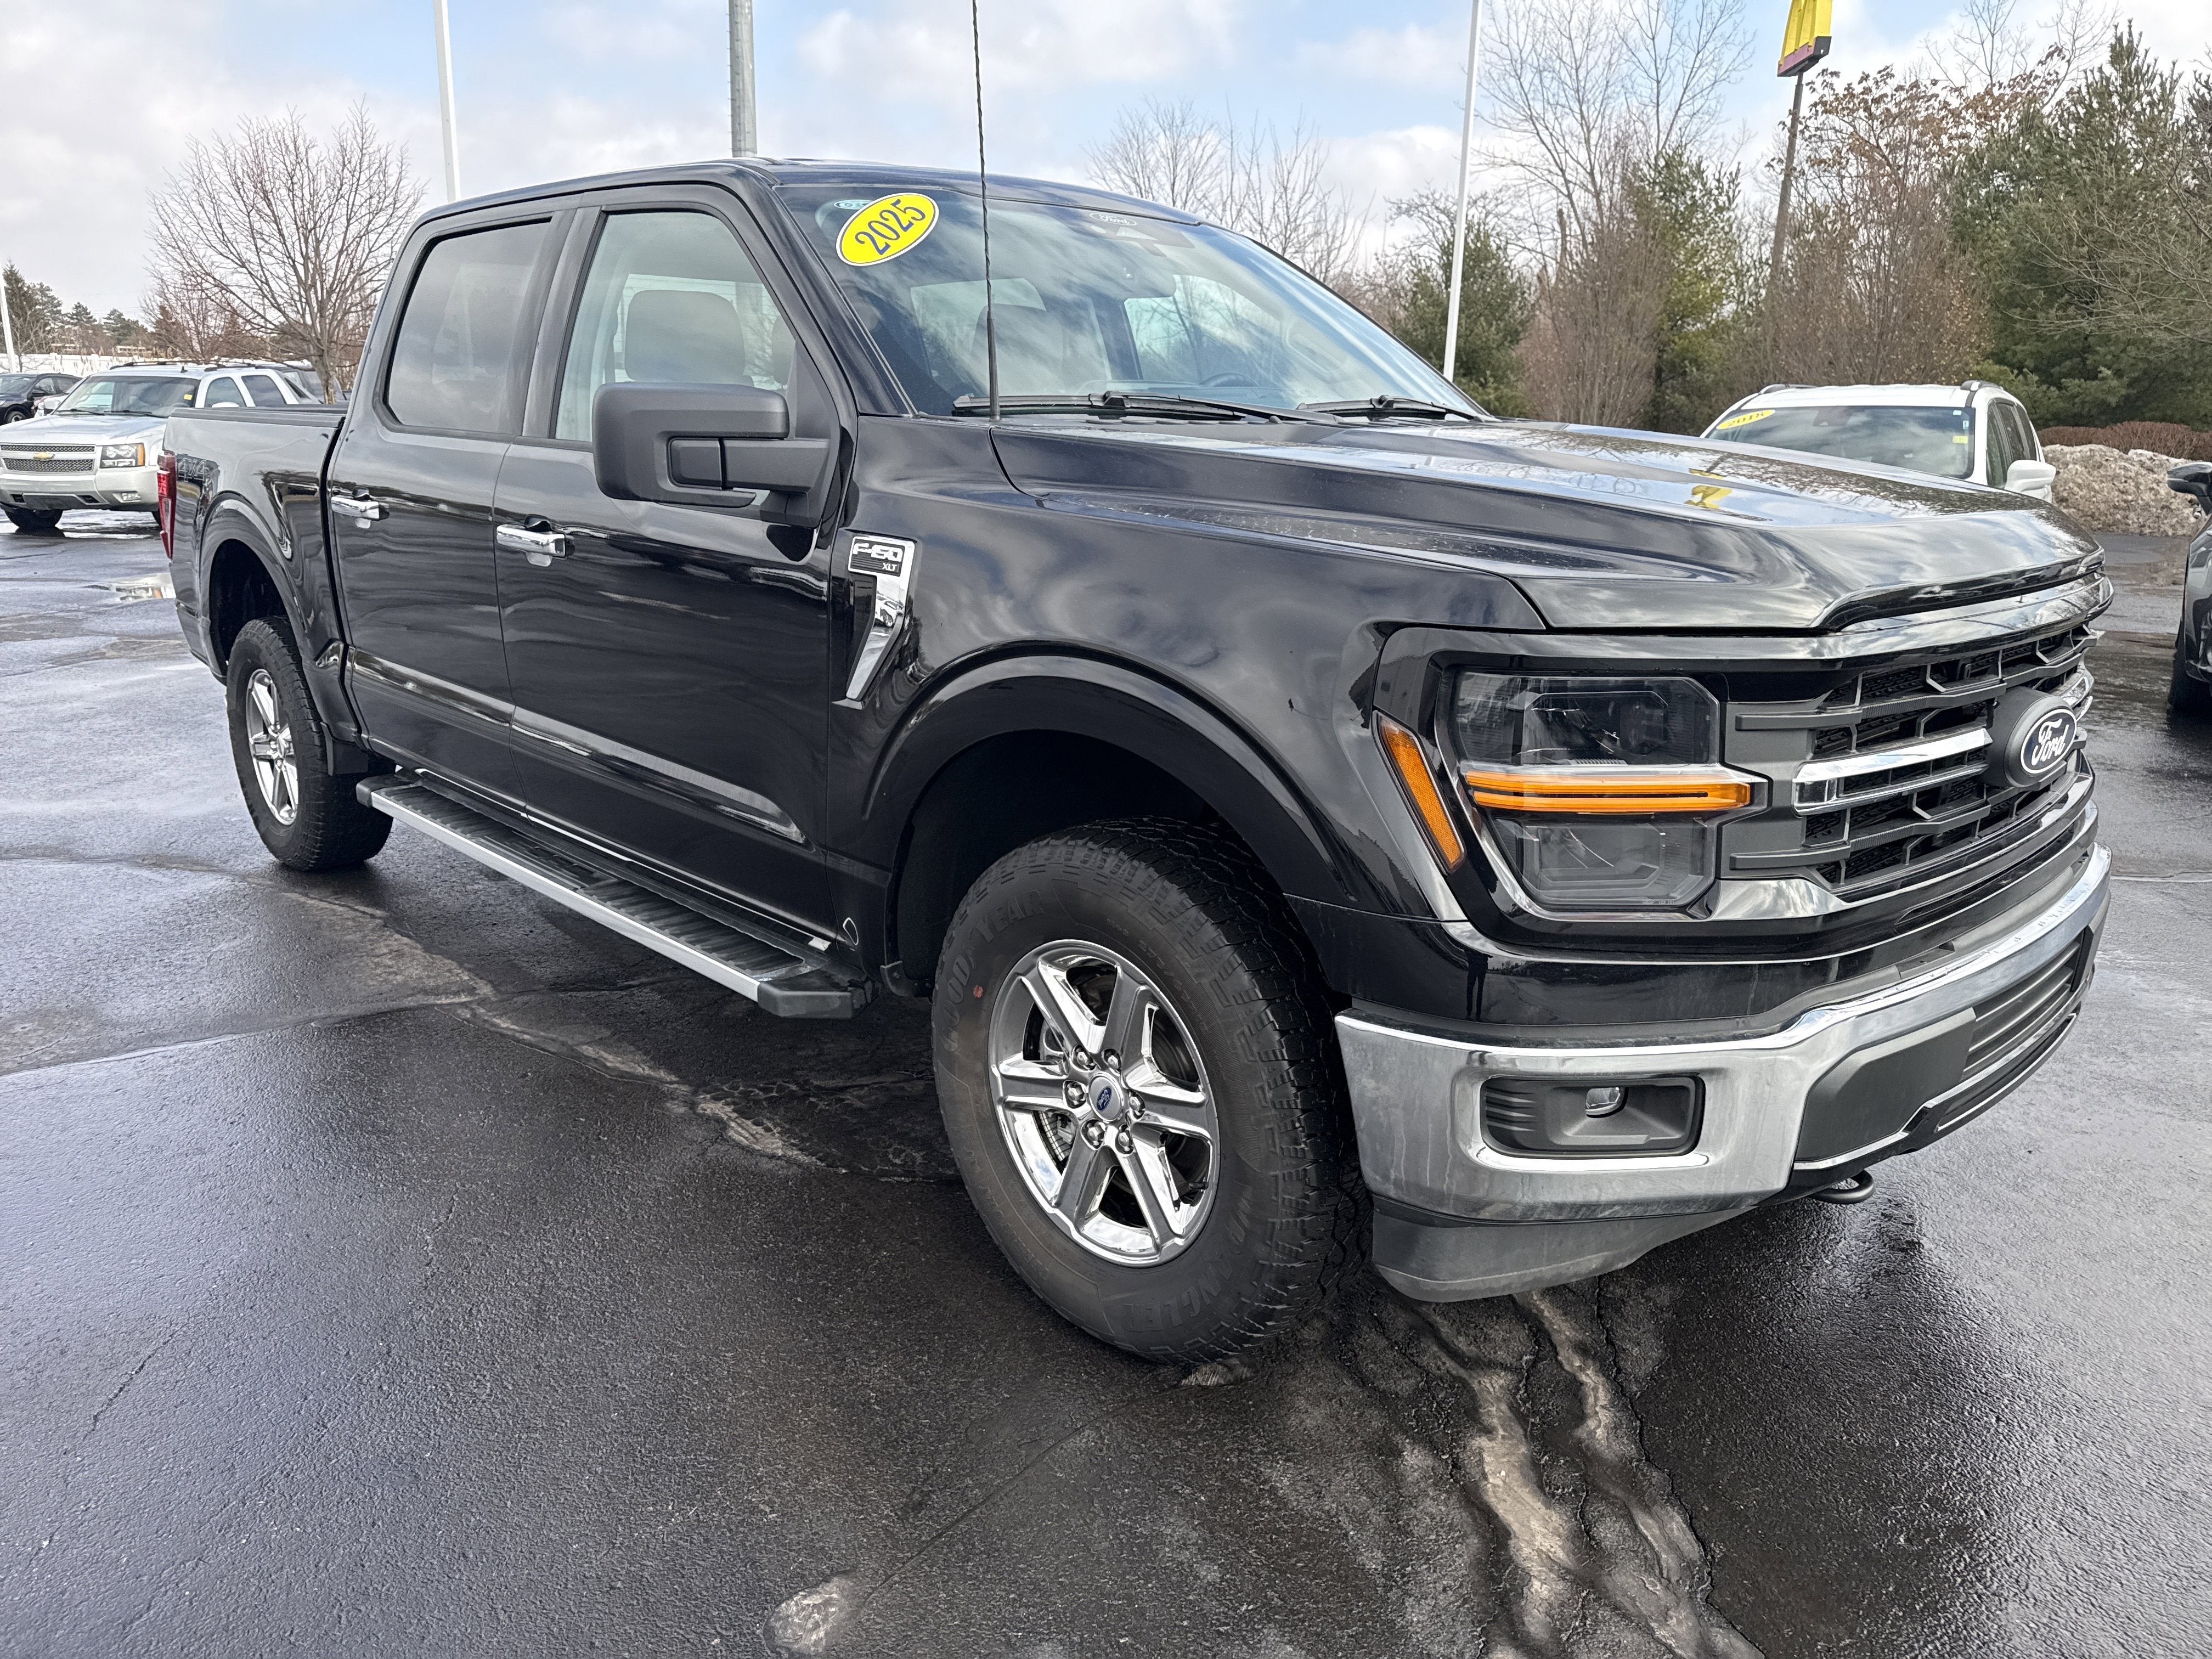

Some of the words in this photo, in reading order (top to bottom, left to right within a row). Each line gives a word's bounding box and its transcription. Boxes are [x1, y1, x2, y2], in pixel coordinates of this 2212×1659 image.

[855, 199, 926, 255] 2025
[1099, 214, 1130, 224] Ford
[852, 543, 904, 562] F-150
[882, 562, 898, 572] XLT
[2031, 718, 2069, 766] Ford
[1098, 1089, 1110, 1108] Ford
[1122, 1180, 1253, 1331] WRANGLER
